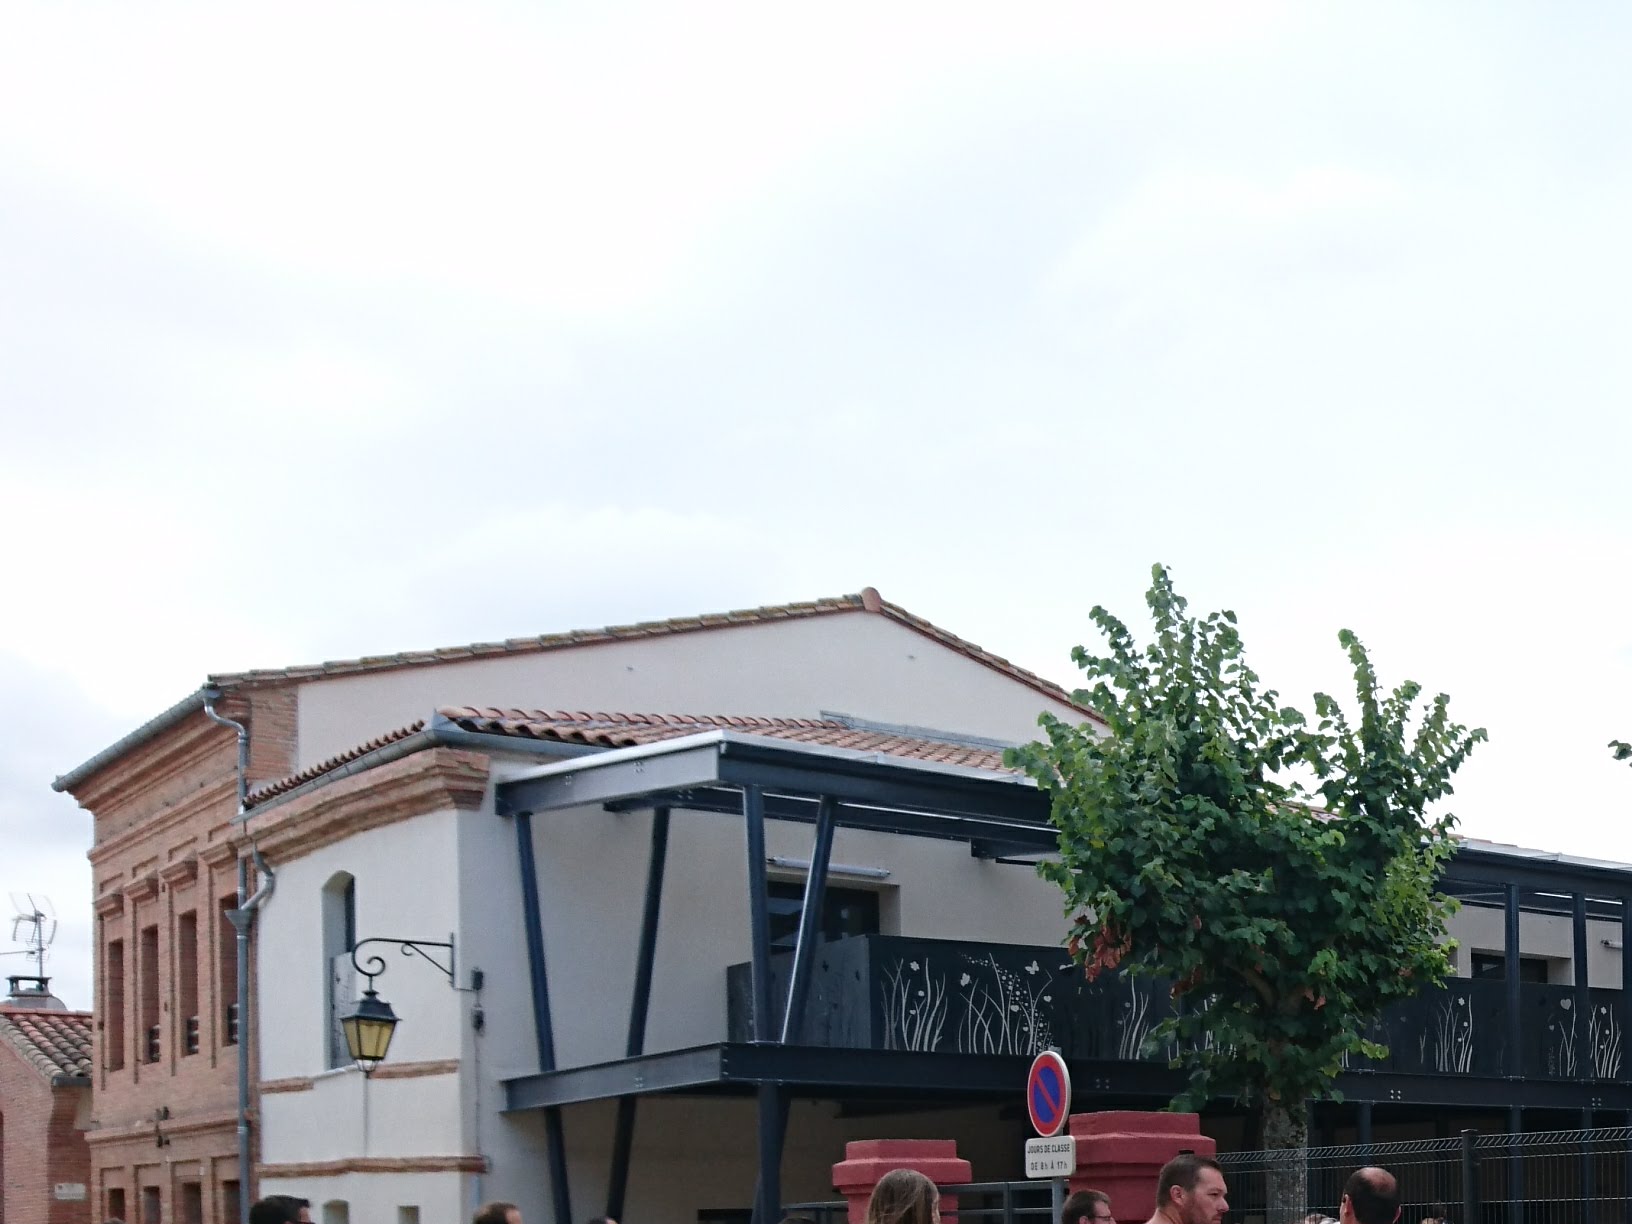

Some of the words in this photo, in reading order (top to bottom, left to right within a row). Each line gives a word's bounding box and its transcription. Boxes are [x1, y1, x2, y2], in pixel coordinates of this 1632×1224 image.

[1027, 1144, 1043, 1154] JOURS
[1044, 1144, 1051, 1153] DE
[1052, 1143, 1070, 1153] CLASSE
[1031, 1162, 1038, 1171] DE
